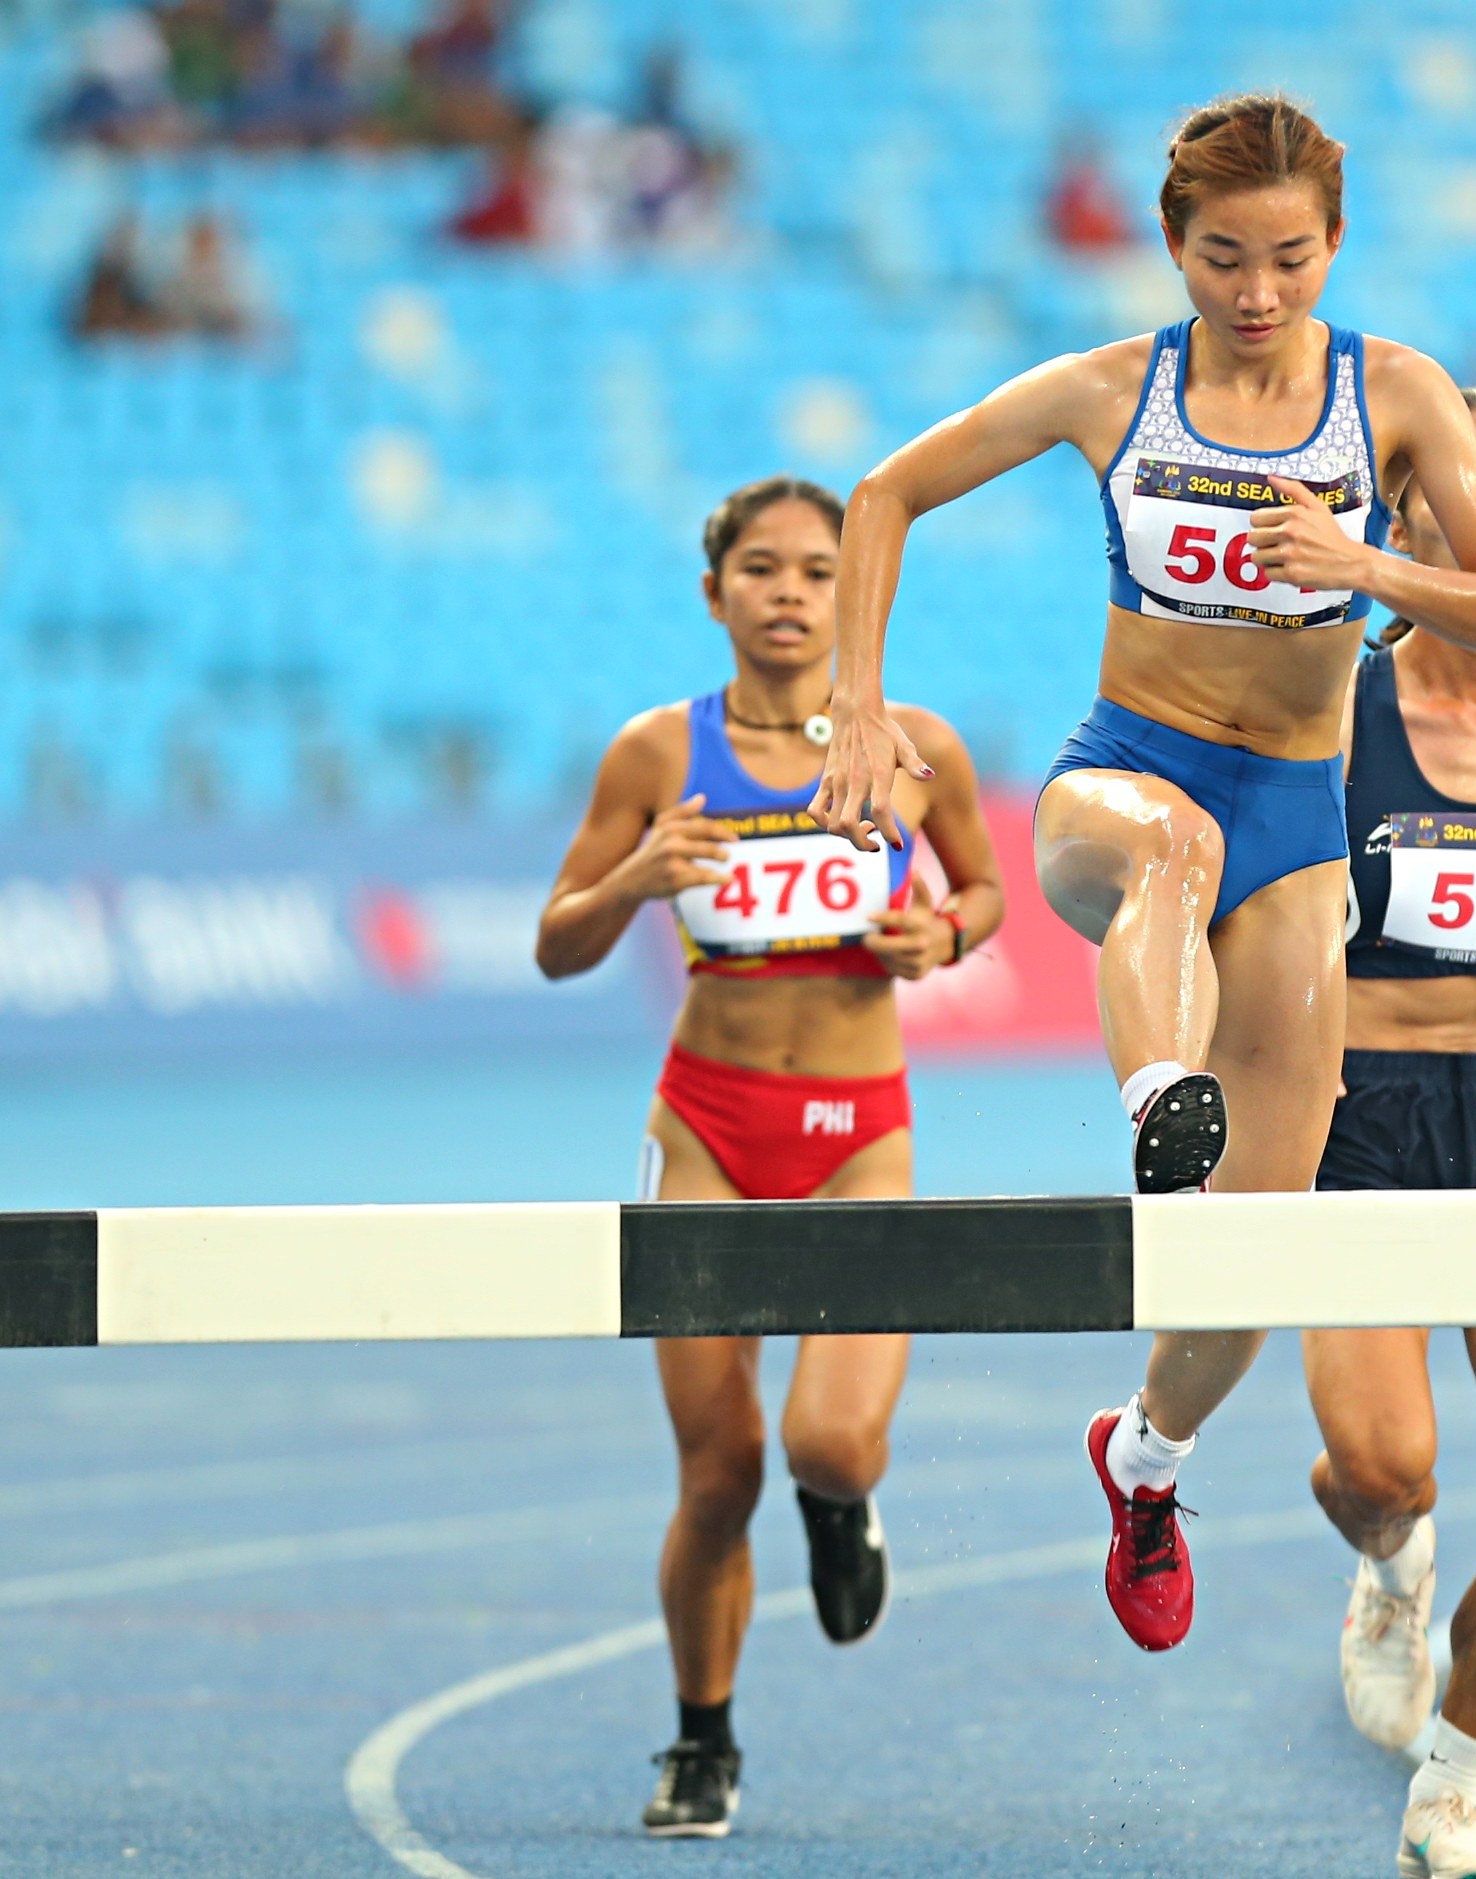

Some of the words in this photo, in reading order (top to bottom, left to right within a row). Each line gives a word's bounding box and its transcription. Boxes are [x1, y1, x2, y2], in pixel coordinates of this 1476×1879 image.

[1187, 475, 1232, 497] 32nd
[1237, 482, 1274, 502] SEA
[1279, 487, 1346, 506] GES
[1164, 524, 1317, 594] 56
[1228, 607, 1252, 619] LIVE
[1255, 611, 1268, 624] IN
[1270, 614, 1306, 628] PEACE
[757, 813, 794, 835] SEA
[714, 857, 861, 919] 476
[1435, 948, 1476, 964] SPORTS
[803, 1100, 855, 1134] PHI
